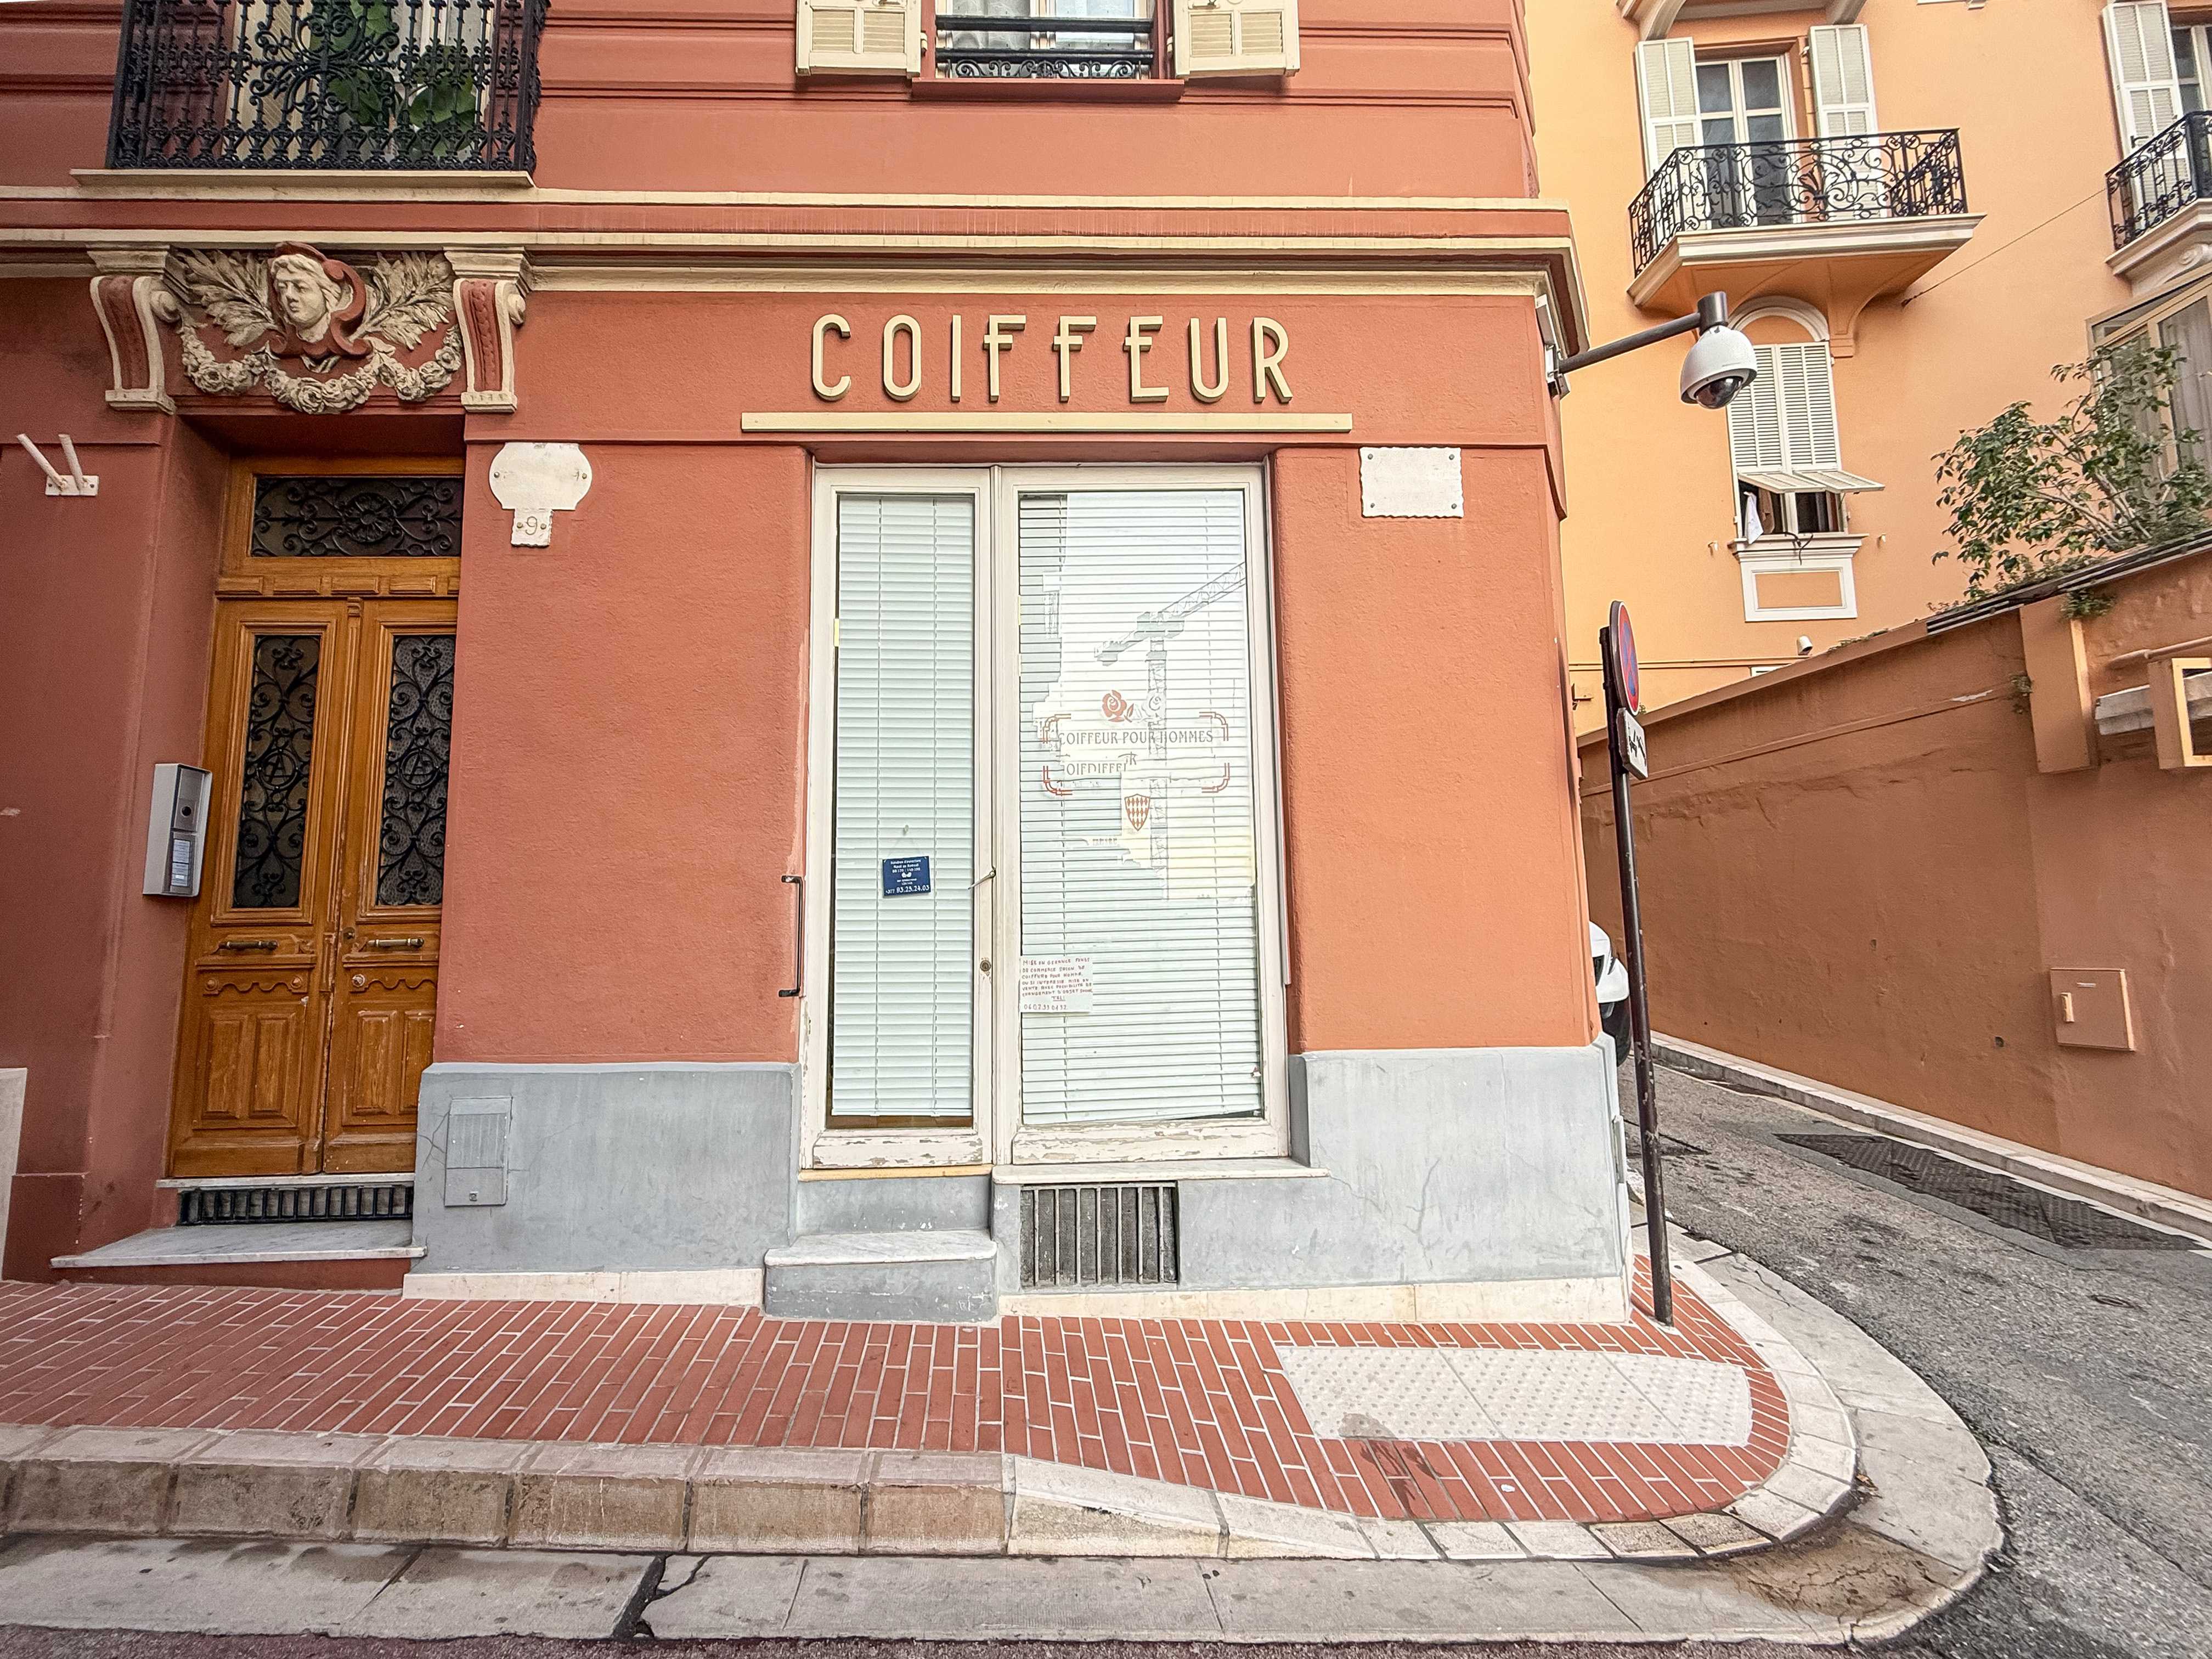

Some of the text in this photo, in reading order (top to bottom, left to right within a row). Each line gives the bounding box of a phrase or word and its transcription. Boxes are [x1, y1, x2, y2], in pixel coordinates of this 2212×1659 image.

[812, 314, 1293, 403] COIFFEUR
[525, 516, 538, 535] 9
[1058, 730, 1214, 745] COIFFEUR POUR HOMMES
